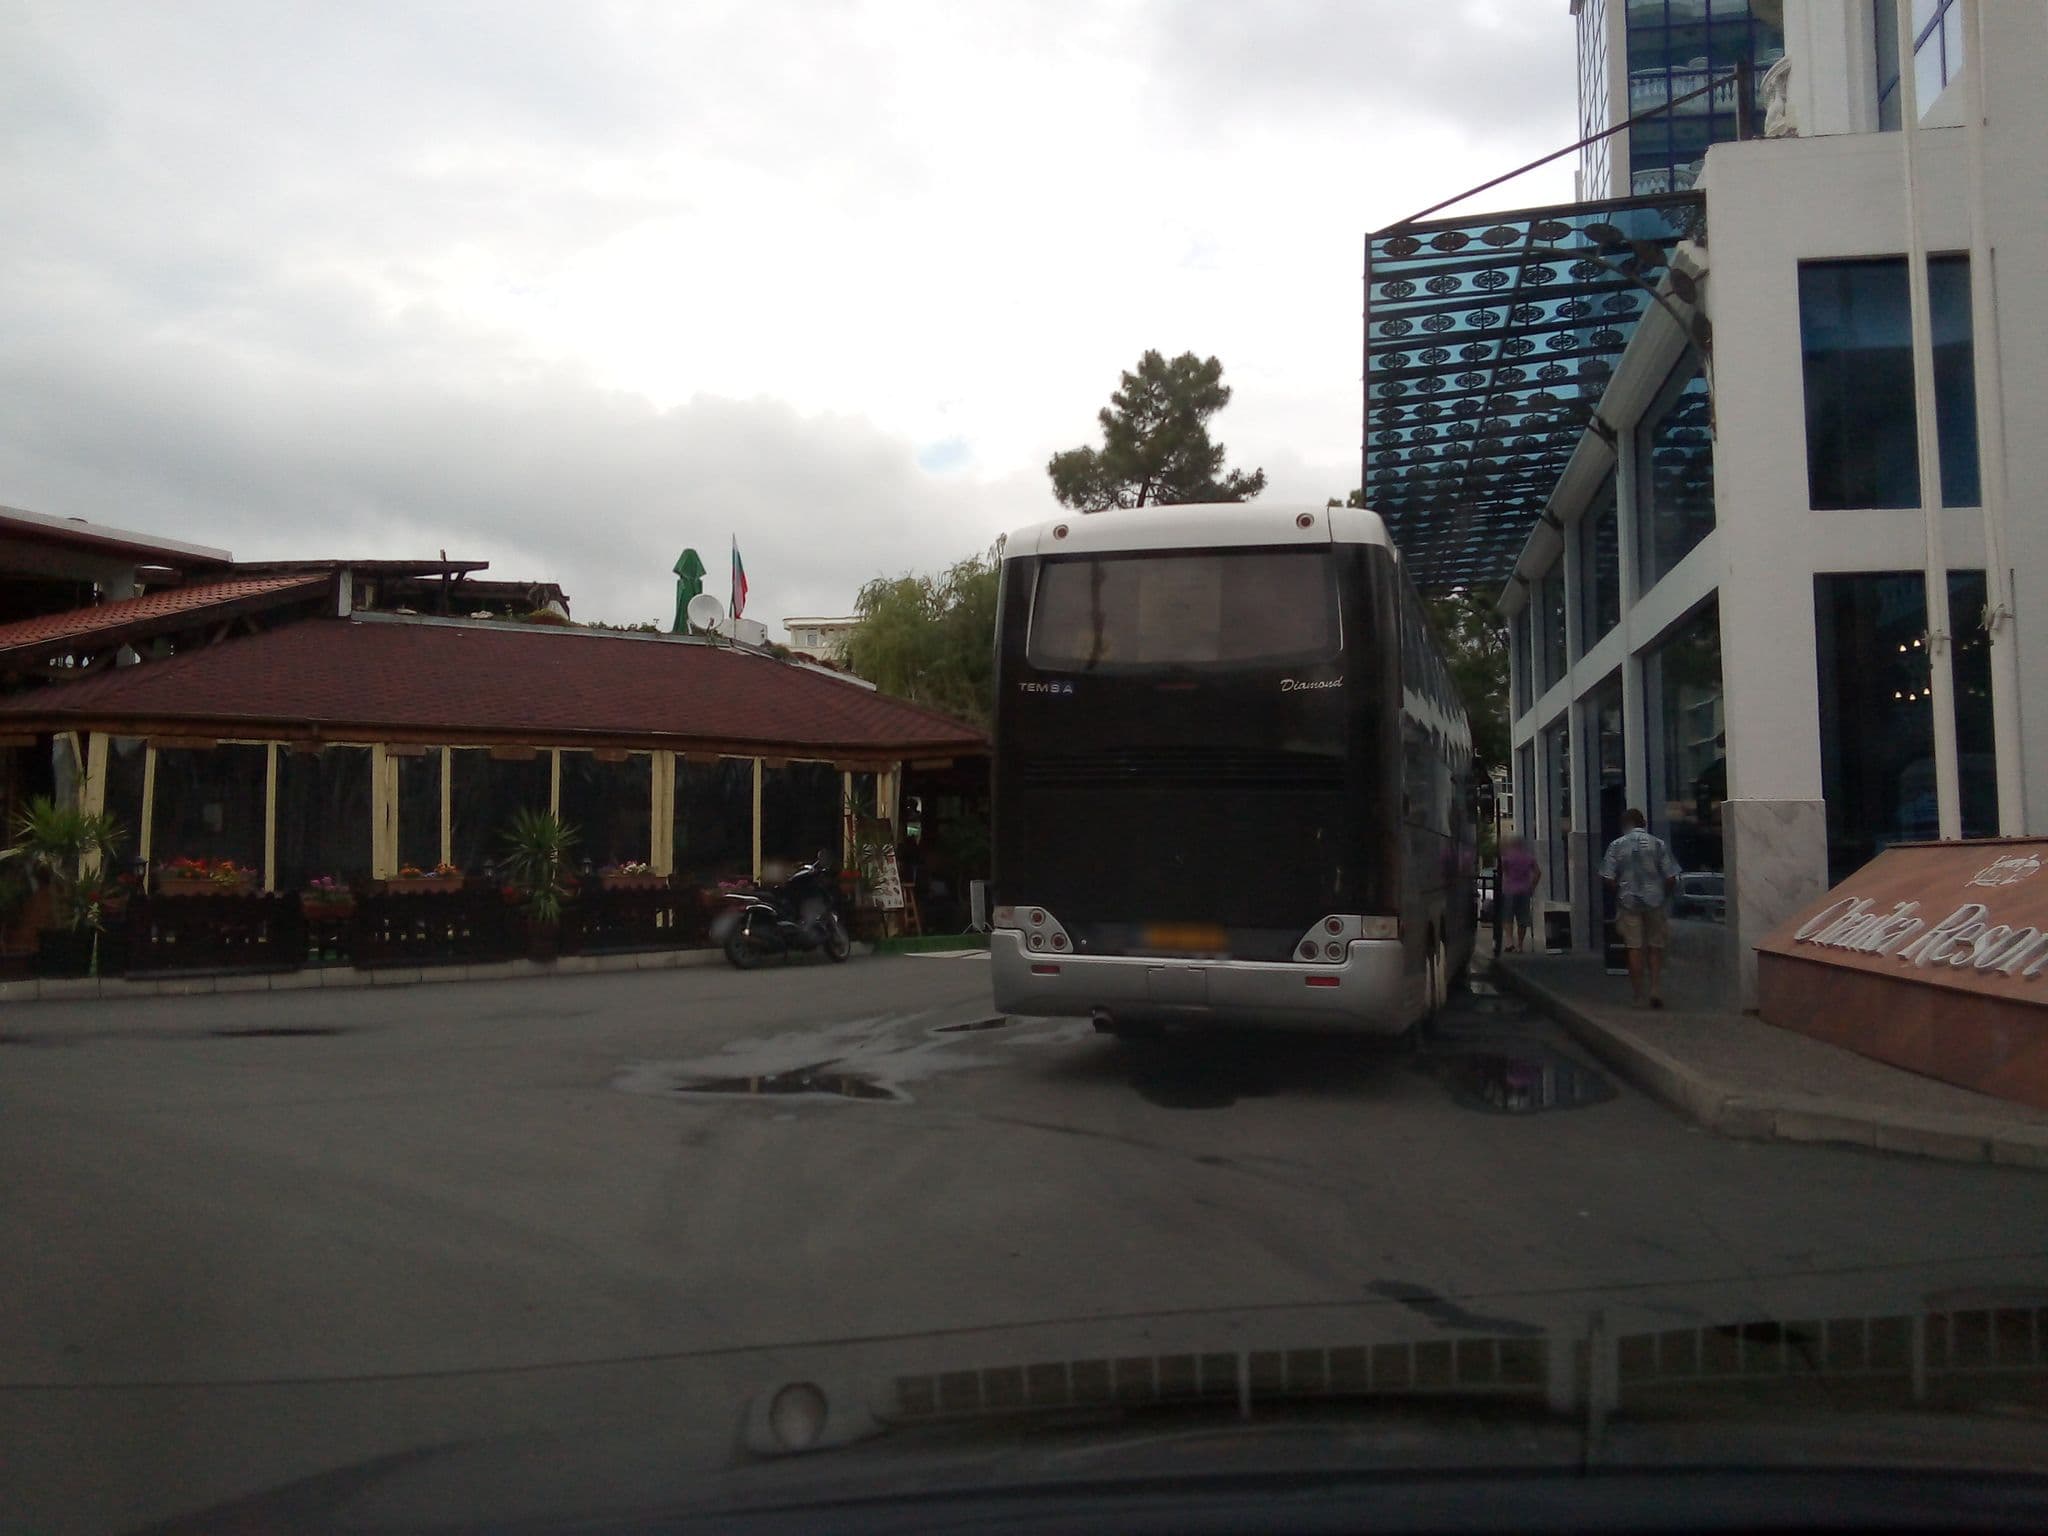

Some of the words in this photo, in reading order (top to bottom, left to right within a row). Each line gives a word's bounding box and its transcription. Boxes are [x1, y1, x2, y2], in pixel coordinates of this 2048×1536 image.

[1018, 682, 1073, 694] TEMSA
[1279, 675, 1343, 692] Diamond
[1793, 896, 1924, 957] Chaika
